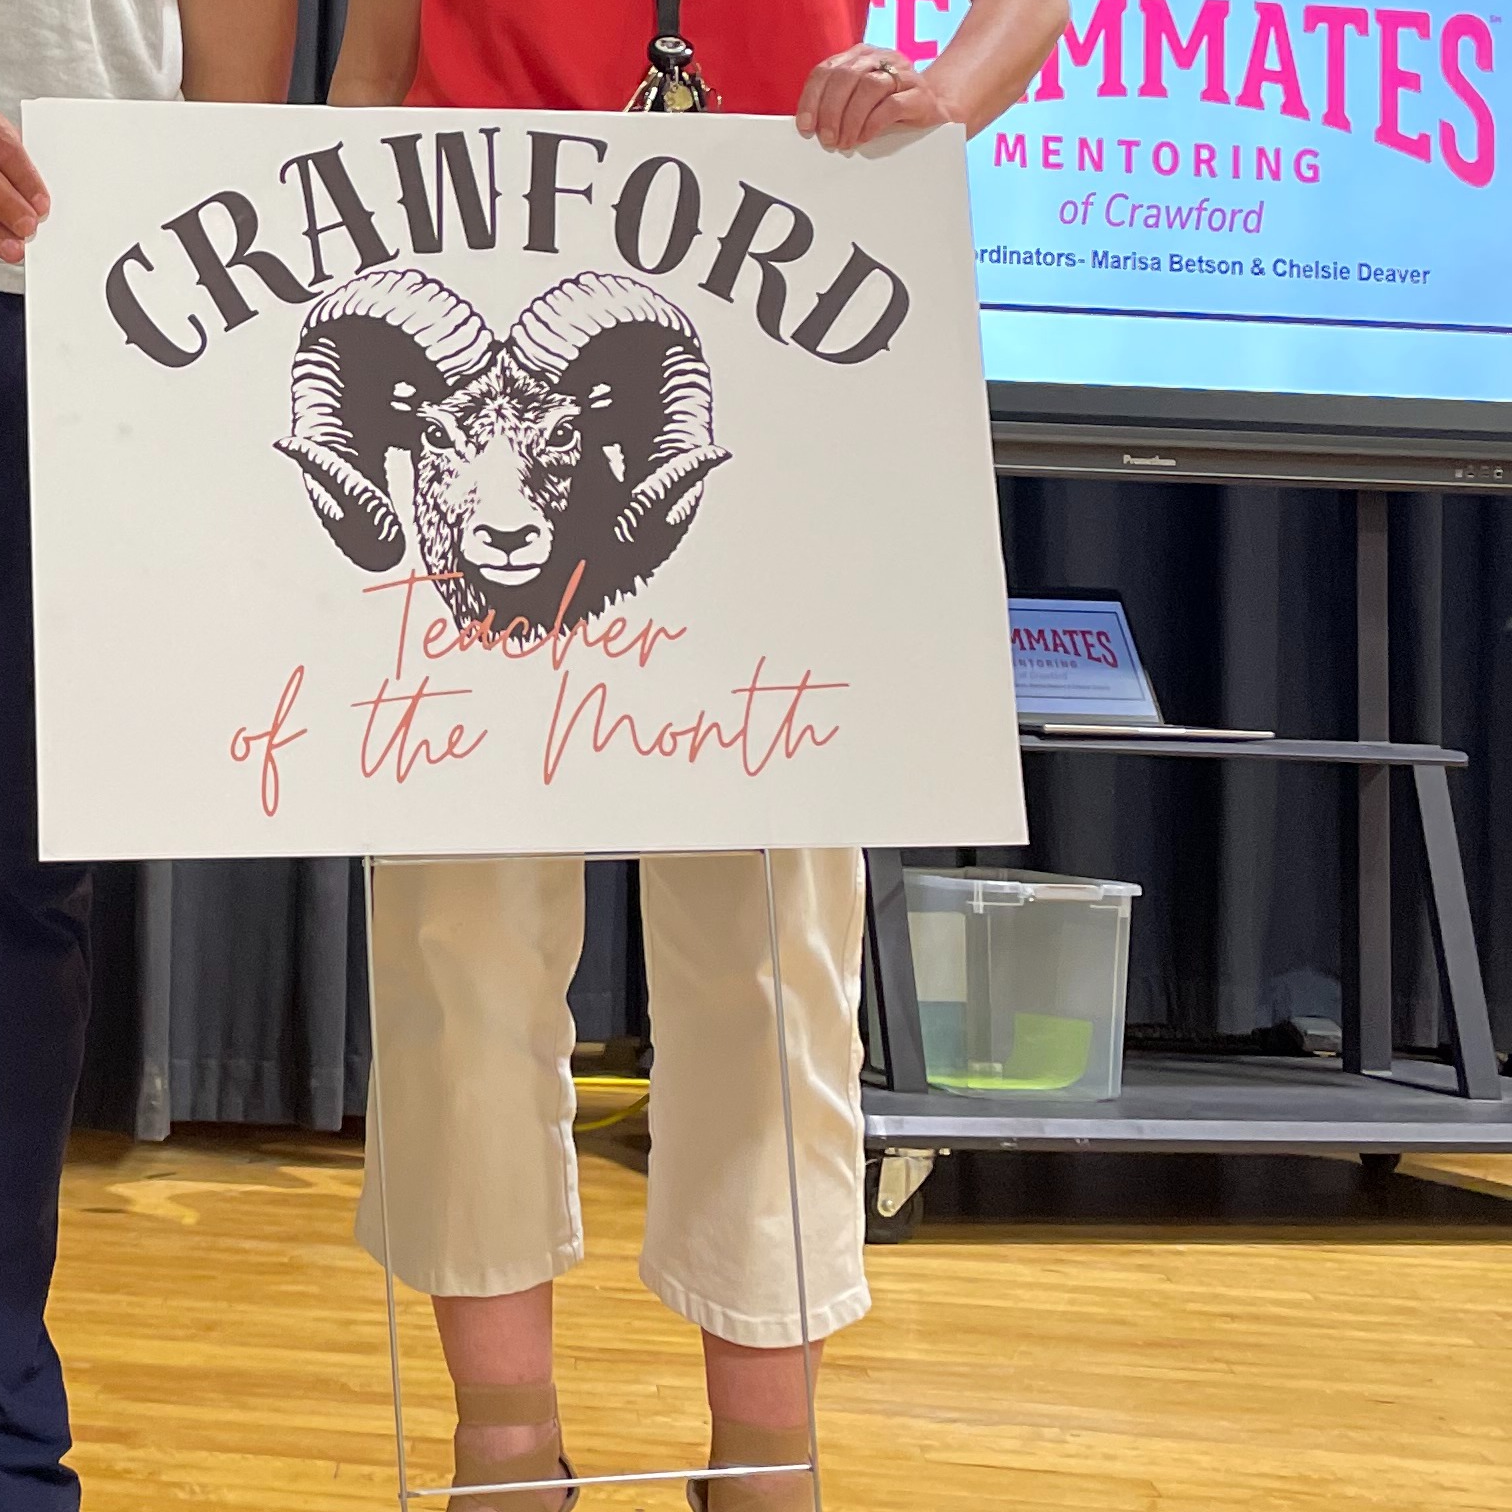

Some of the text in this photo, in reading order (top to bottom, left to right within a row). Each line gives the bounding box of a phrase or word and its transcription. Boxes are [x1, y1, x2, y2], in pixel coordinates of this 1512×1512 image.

[993, 132, 1321, 183] MENTORING
[1059, 192, 1265, 234] of Crawford
[104, 126, 910, 369] CRAWFORD
[975, 245, 1431, 285] rdinators- Marisa Betson & Chelsie Deaver
[362, 559, 687, 682] Teacher
[1011, 627, 1119, 668] MMATES
[229, 656, 851, 817] of the Month
